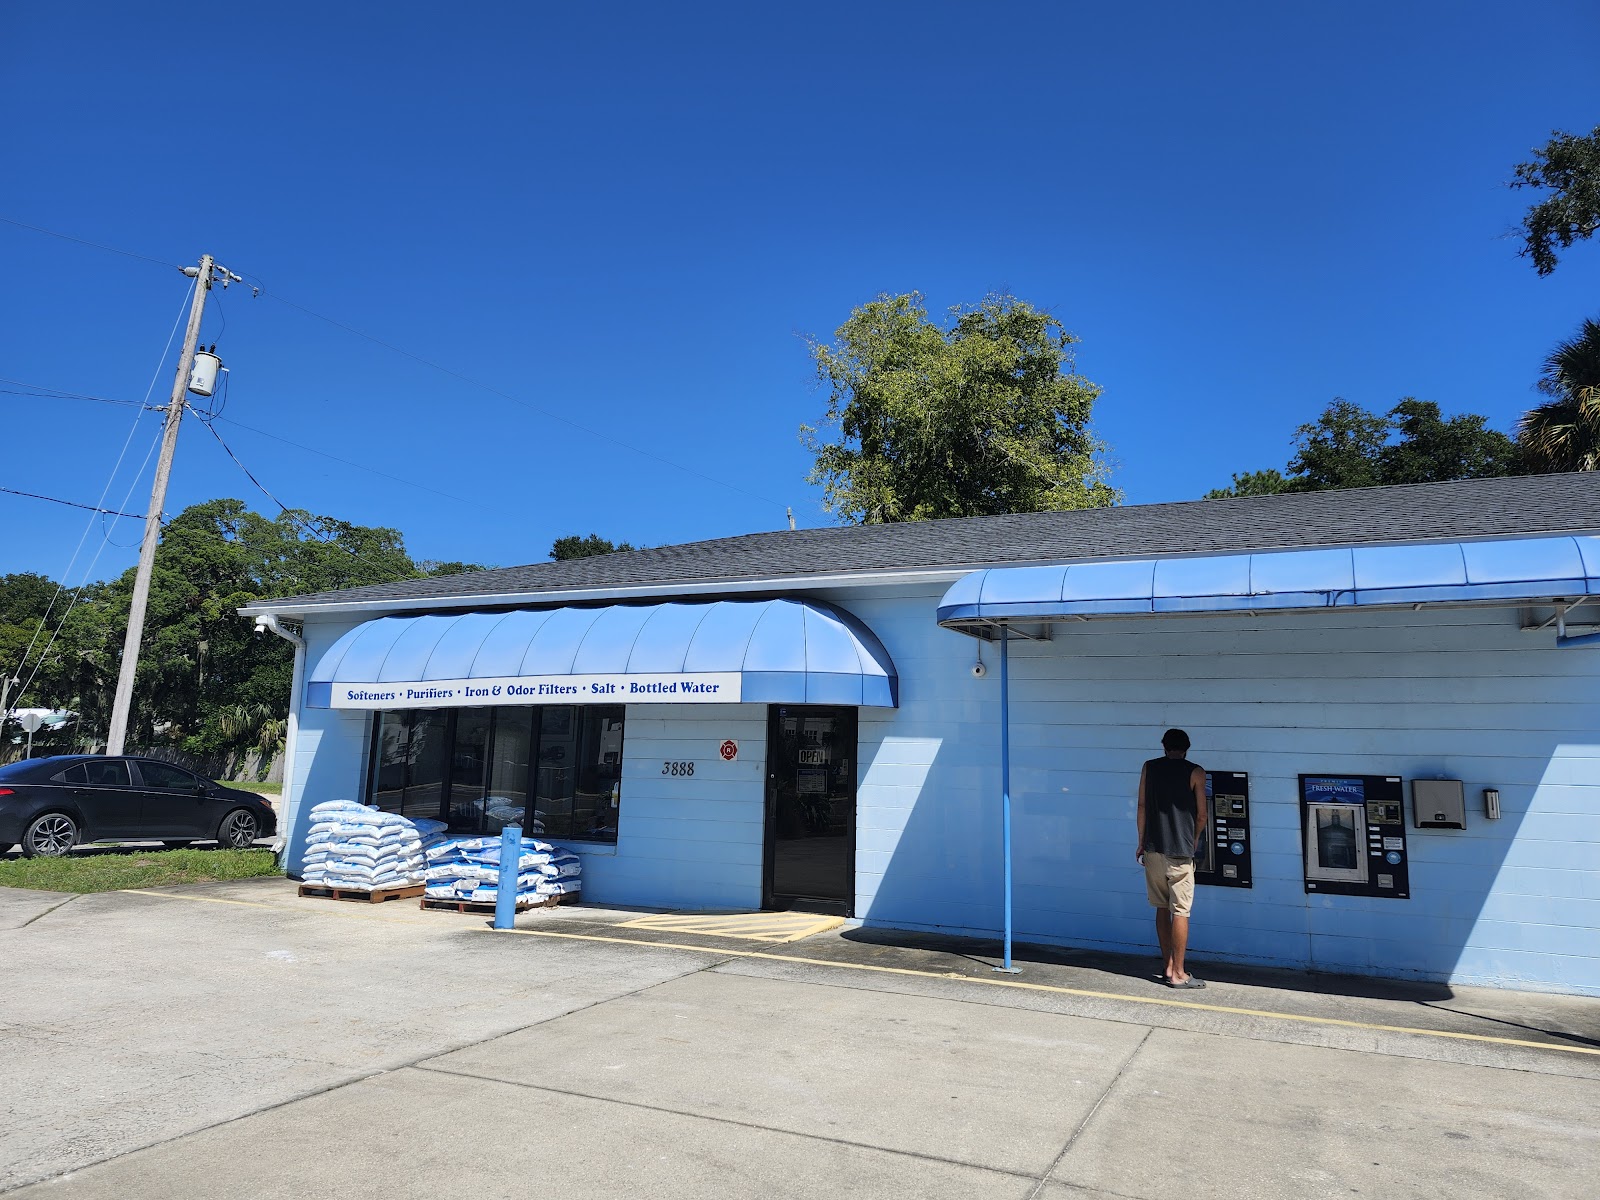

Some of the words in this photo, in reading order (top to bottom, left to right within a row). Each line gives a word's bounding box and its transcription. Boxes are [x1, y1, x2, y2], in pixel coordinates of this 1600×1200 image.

[347, 690, 395, 700] Softeners
[406, 688, 453, 699] Purifiers
[465, 686, 489, 697] Iron
[491, 685, 502, 696] &
[507, 684, 536, 696] Odor
[538, 683, 577, 695] Filters
[591, 682, 616, 694] Salt
[630, 682, 677, 694] Bottled
[680, 681, 720, 693] Water
[801, 750, 823, 763] OPEN
[661, 761, 695, 776] 3888
